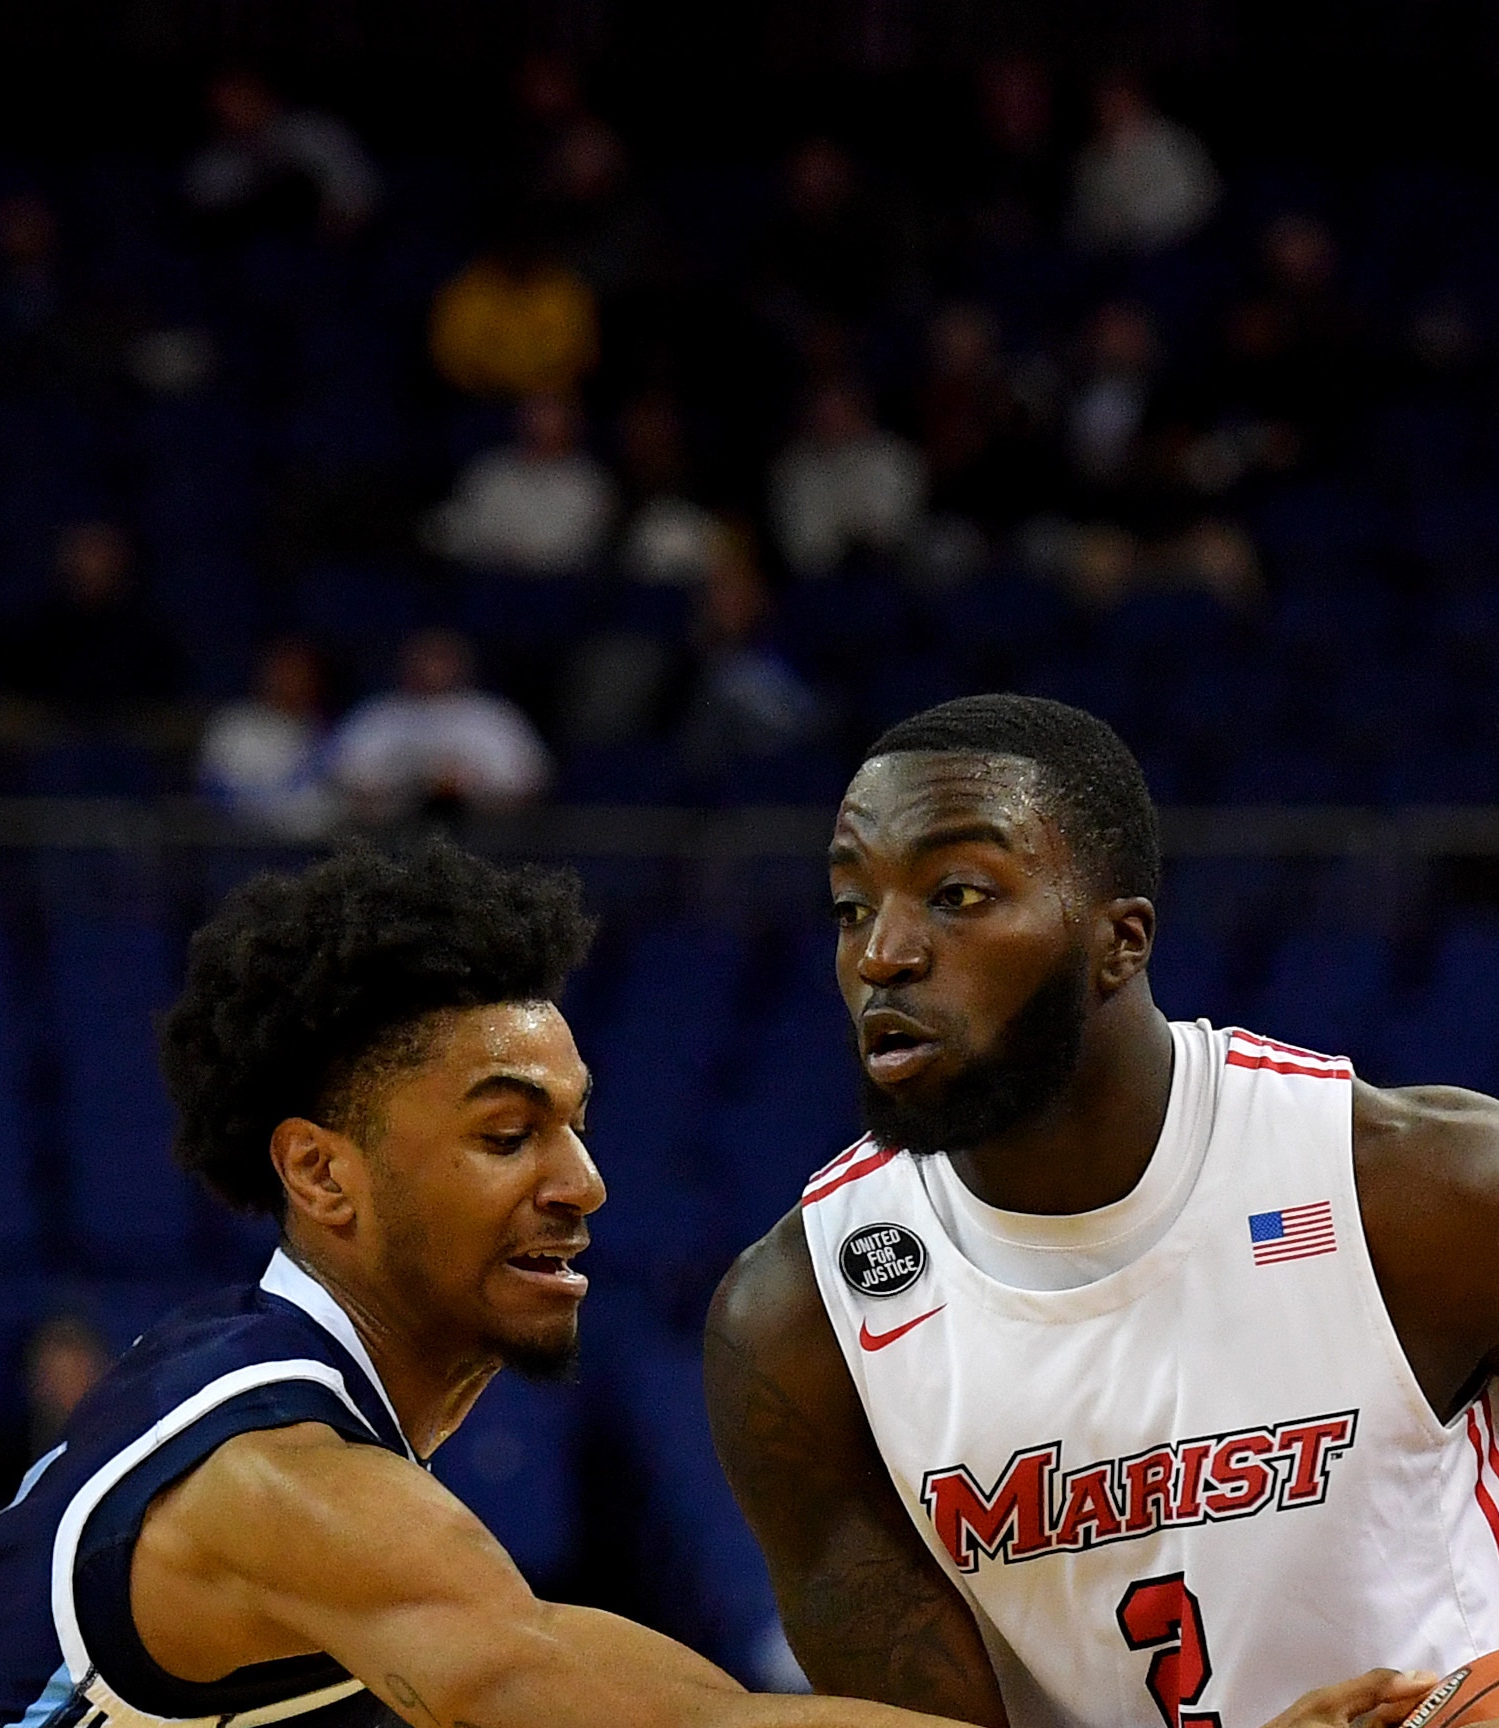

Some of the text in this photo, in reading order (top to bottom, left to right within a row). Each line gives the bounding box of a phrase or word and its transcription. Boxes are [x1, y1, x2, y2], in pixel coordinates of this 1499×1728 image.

[850, 1229, 901, 1255] UNITED
[867, 1246, 896, 1267] FOR
[861, 1255, 918, 1287] JUSTICE
[920, 1409, 1359, 1573] MARIST
